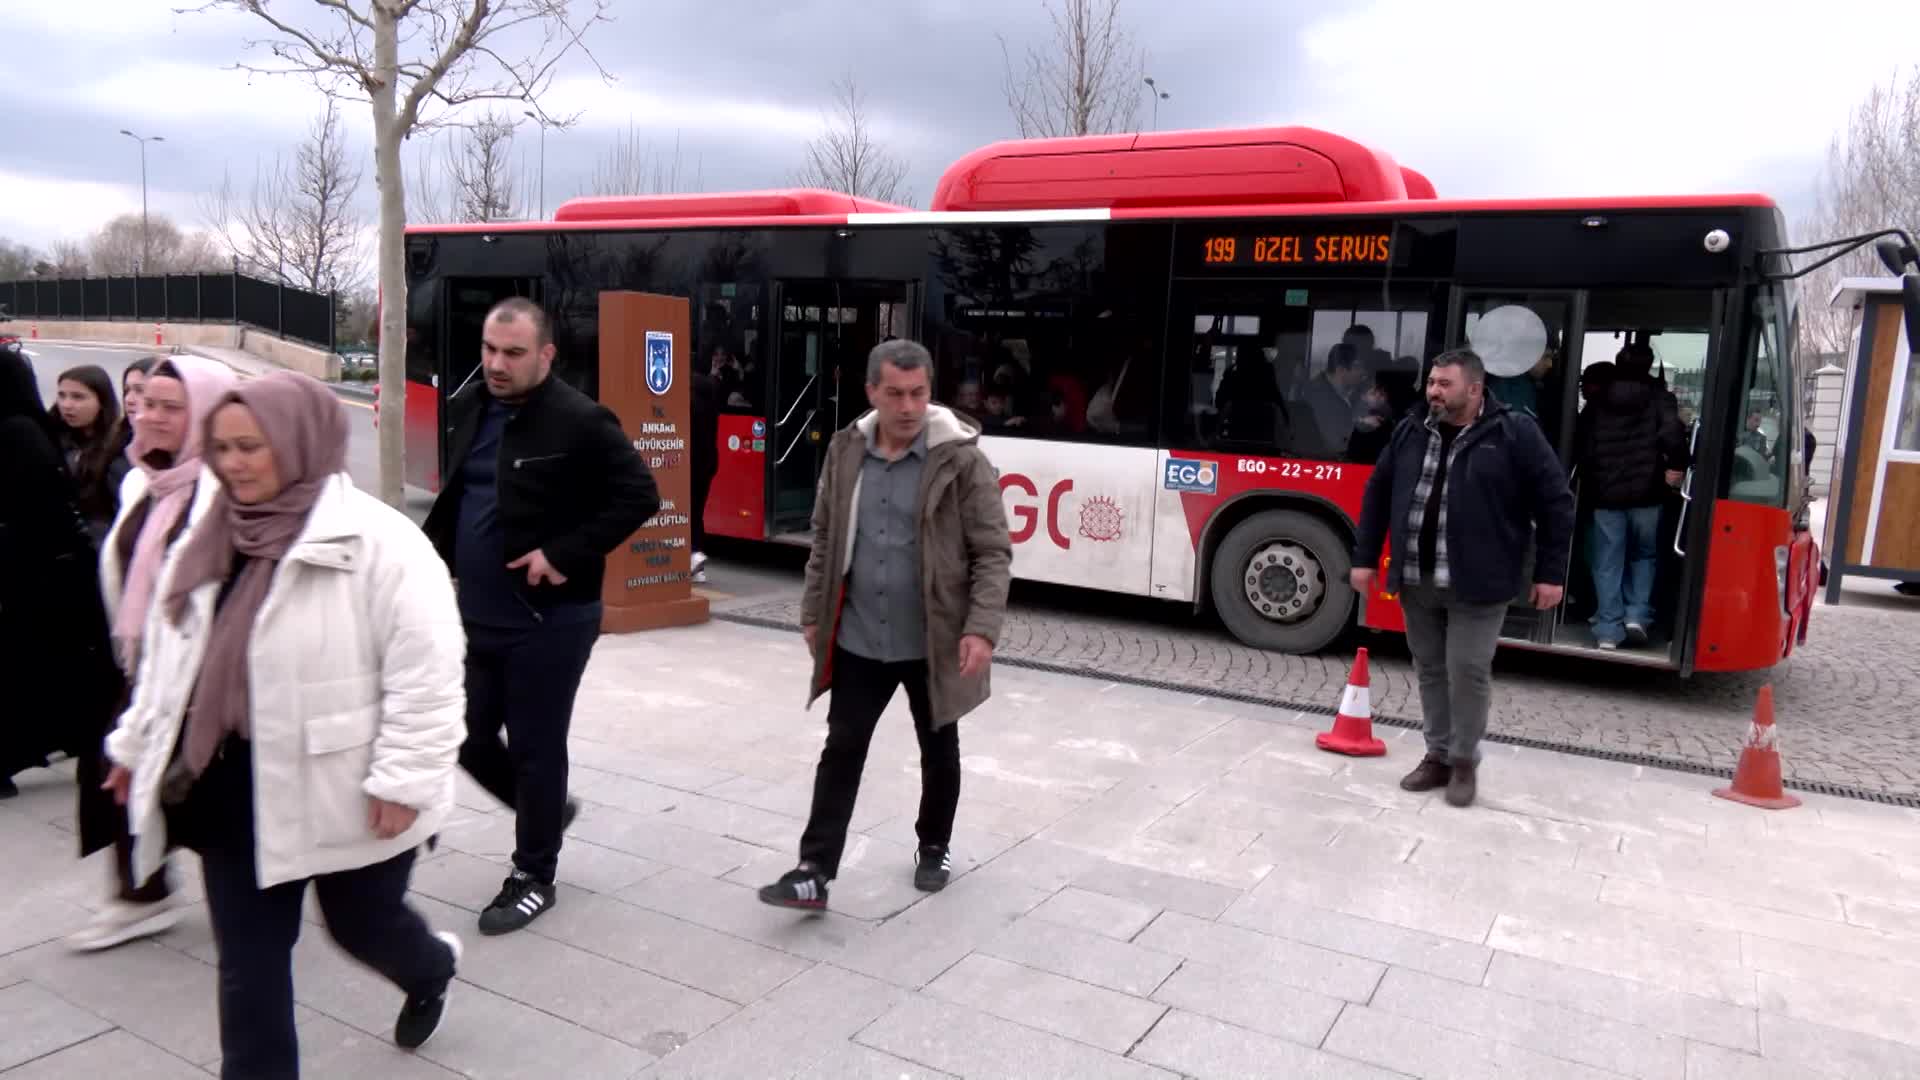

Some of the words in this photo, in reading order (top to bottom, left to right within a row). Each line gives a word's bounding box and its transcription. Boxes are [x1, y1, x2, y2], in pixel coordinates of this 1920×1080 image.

[1204, 237, 1235, 262] 199
[1254, 236, 1303, 262] ÖZEL
[1167, 464, 1214, 486] EGO
[1238, 459, 1266, 474] EGO
